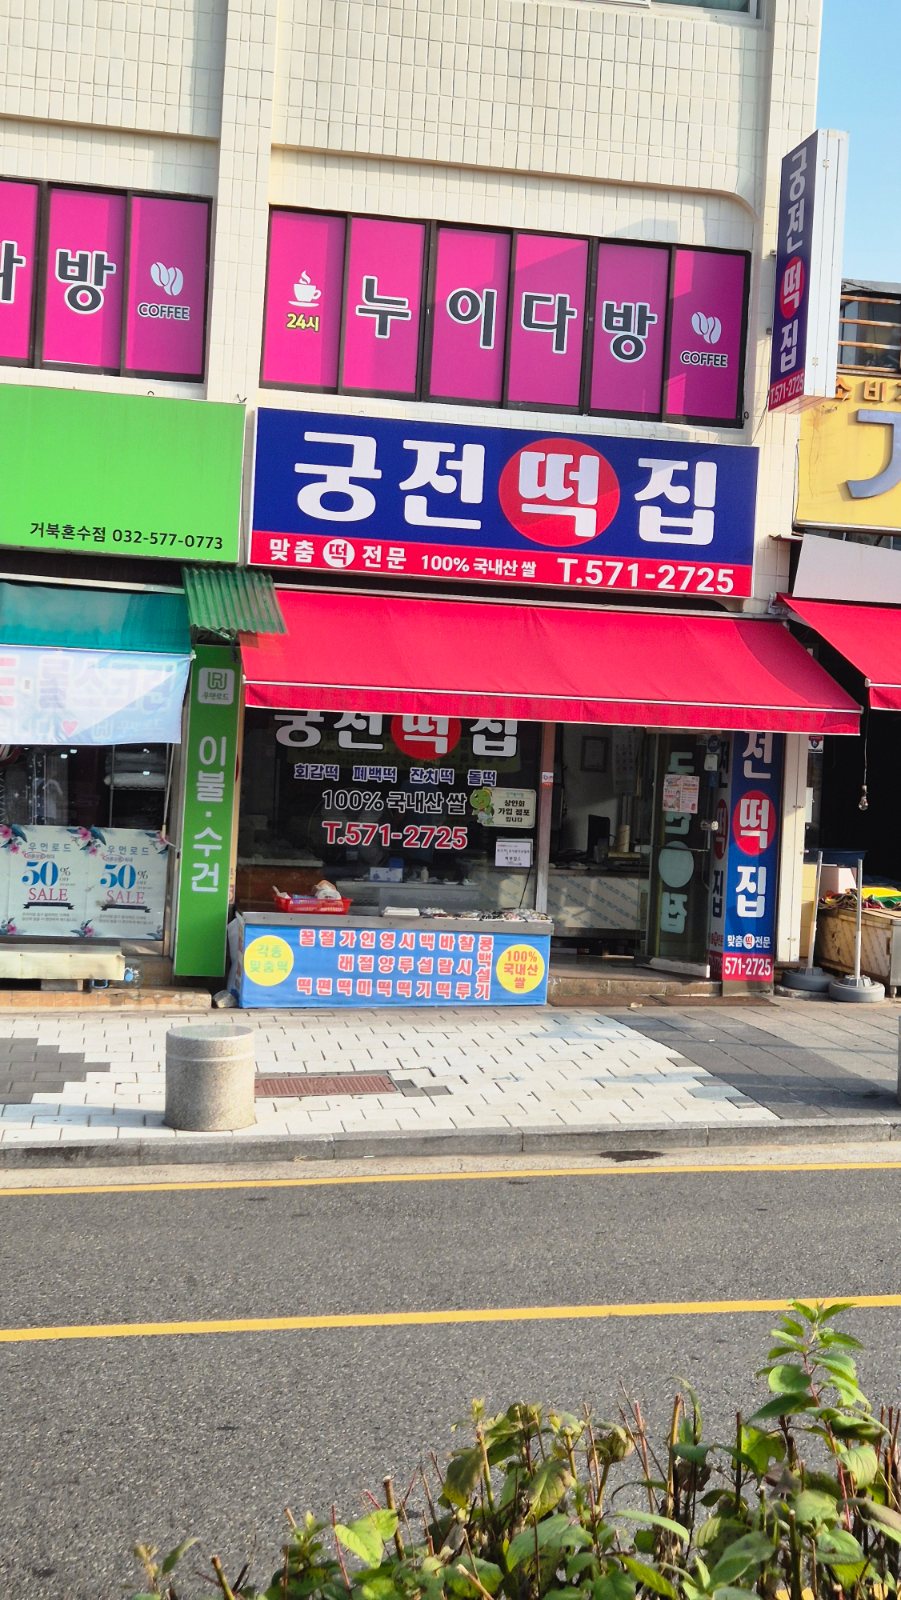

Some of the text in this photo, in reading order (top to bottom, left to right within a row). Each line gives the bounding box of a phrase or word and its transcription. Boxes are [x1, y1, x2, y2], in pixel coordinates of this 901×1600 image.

[780, 146, 807, 373] 궁전떡집
[138, 302, 190, 321] COFFEE
[285, 312, 320, 333] 24시
[355, 274, 659, 363] 누이다방
[680, 350, 729, 368] COFFEE
[769, 373, 805, 405] T.571-2725
[294, 431, 717, 546] 궁전떡집
[29, 521, 224, 549] 거북혼수점 032-577-0773
[421, 554, 537, 578] 100% 국내산 쌀
[557, 557, 735, 593] T.571-2725
[294, 764, 340, 781] 회갑떡
[410, 767, 455, 785] 잔치떡
[467, 770, 498, 787] 돌떡
[322, 790, 468, 815] 100% 국내산 쌀
[322, 821, 468, 850] T.571-2725
[28, 887, 68, 901] SALE
[106, 890, 145, 904] SALE
[507, 951, 537, 962] 100%
[725, 957, 771, 976] 571-2725
[503, 962, 538, 976] 국내산
[514, 977, 525, 989] 쌀
